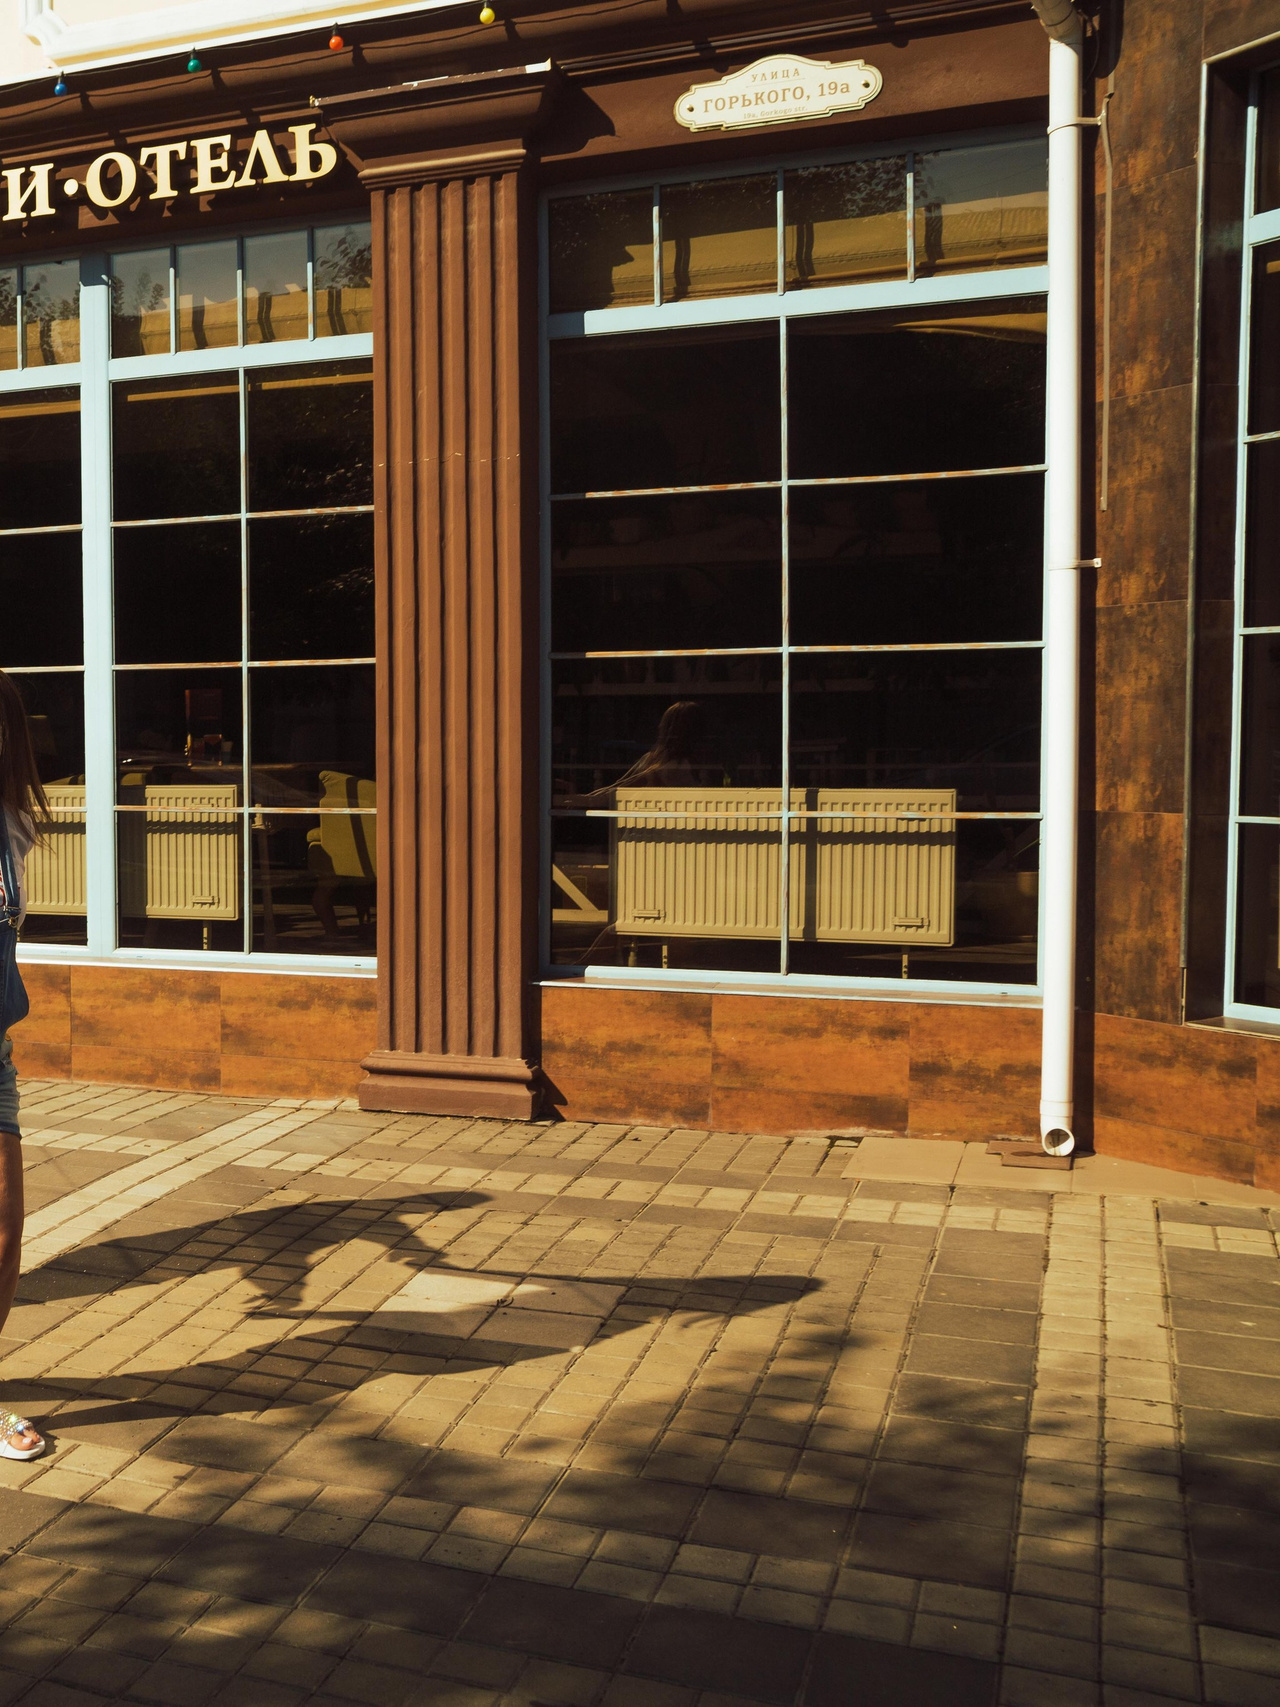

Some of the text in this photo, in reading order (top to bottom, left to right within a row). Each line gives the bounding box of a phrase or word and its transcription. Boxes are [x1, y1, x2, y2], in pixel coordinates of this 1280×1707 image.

[751, 68, 801, 83] УЛИЦА
[703, 86, 811, 113] ГОРЬКОГО,
[85, 123, 337, 208] ОТЕЛЬ
